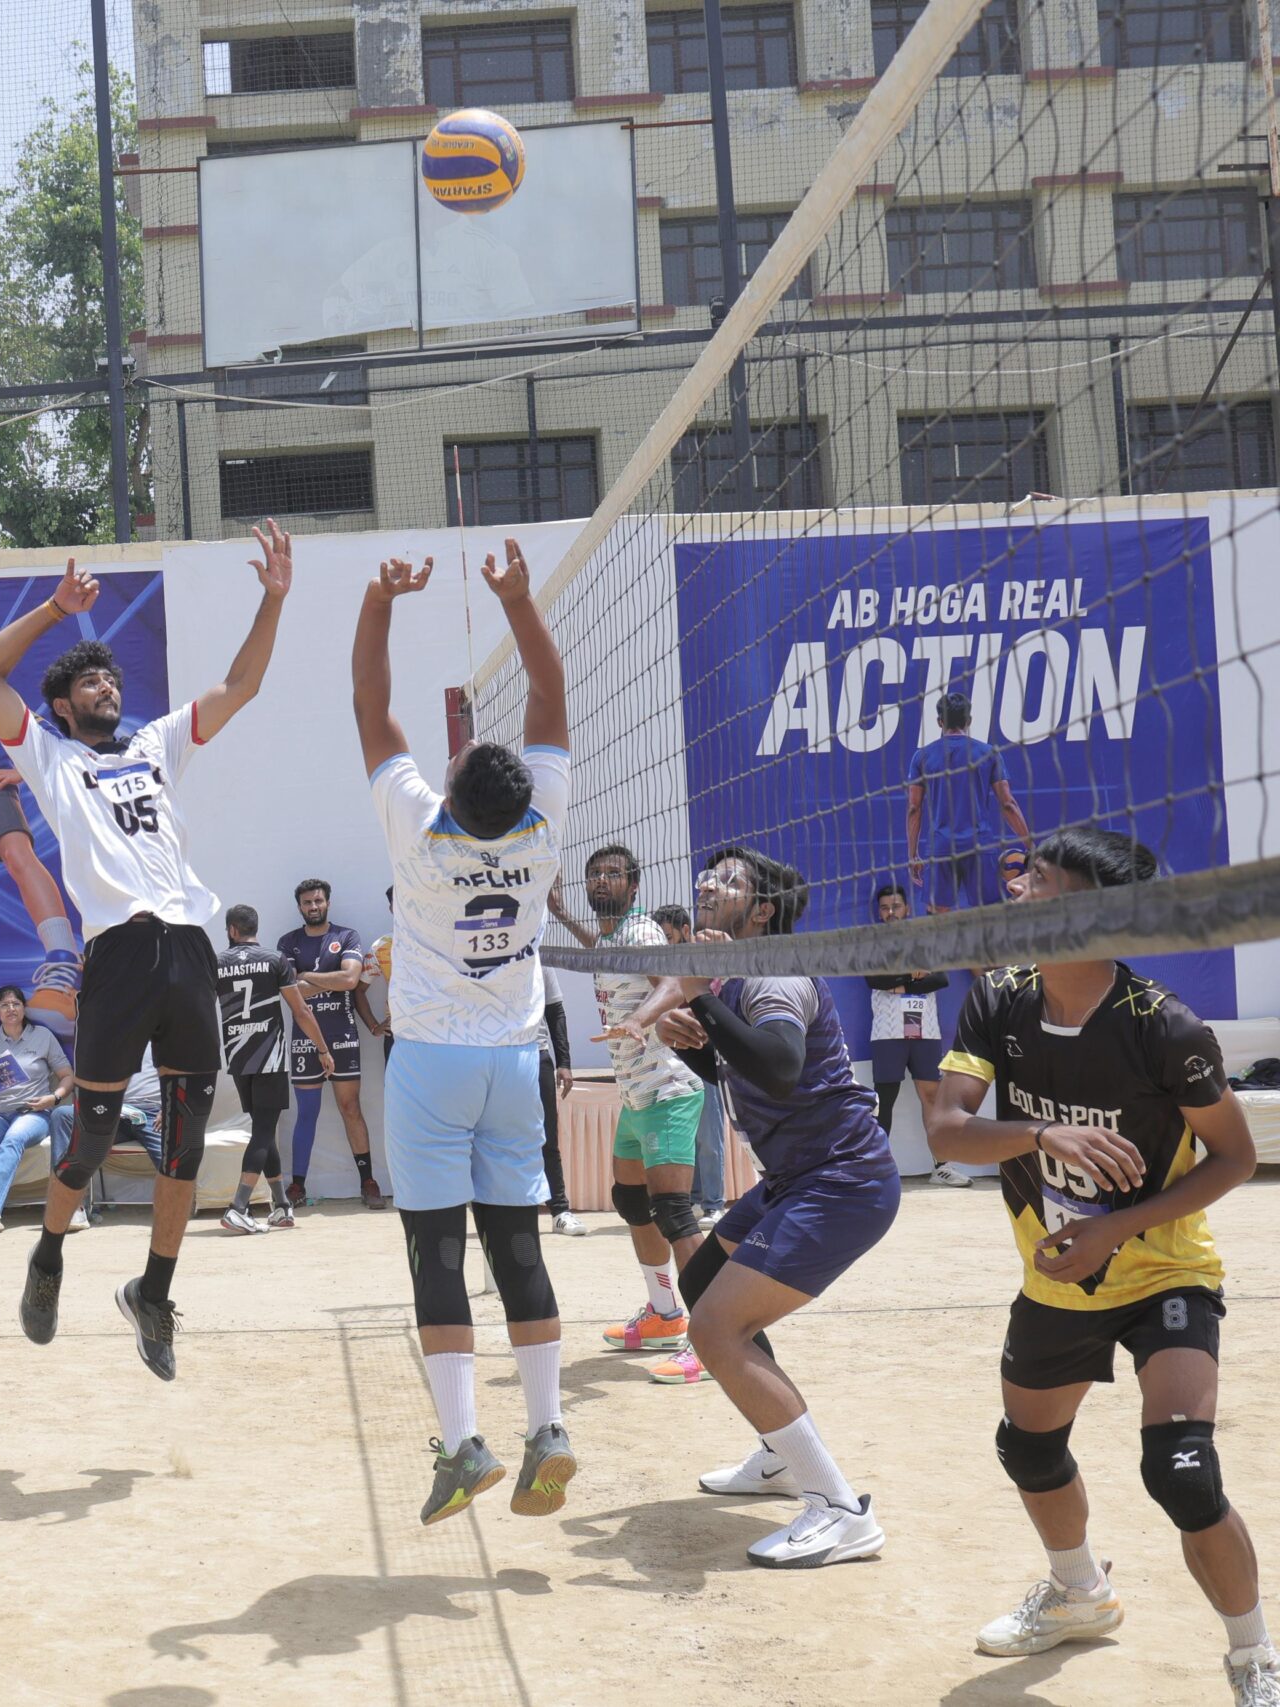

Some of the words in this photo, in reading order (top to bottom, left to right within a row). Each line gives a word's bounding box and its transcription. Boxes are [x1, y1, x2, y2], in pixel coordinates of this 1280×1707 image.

[432, 182, 493, 198] SPARTAN
[827, 588, 879, 630] AB
[890, 582, 987, 627] HOGA
[999, 577, 1088, 621] REAL
[756, 625, 1146, 757] ACTION
[111, 776, 147, 797] 115
[113, 794, 159, 837] 05
[468, 932, 510, 953] 133
[217, 961, 270, 979] RAJASTHAN
[233, 978, 254, 1020] 7
[906, 1000, 924, 1009] 128
[227, 1022, 269, 1036] SPARTAN
[296, 1056, 306, 1073] 3
[1008, 1081, 1056, 1121] GOLD
[1058, 1103, 1122, 1134] SPOT
[1162, 1295, 1189, 1331] 8
